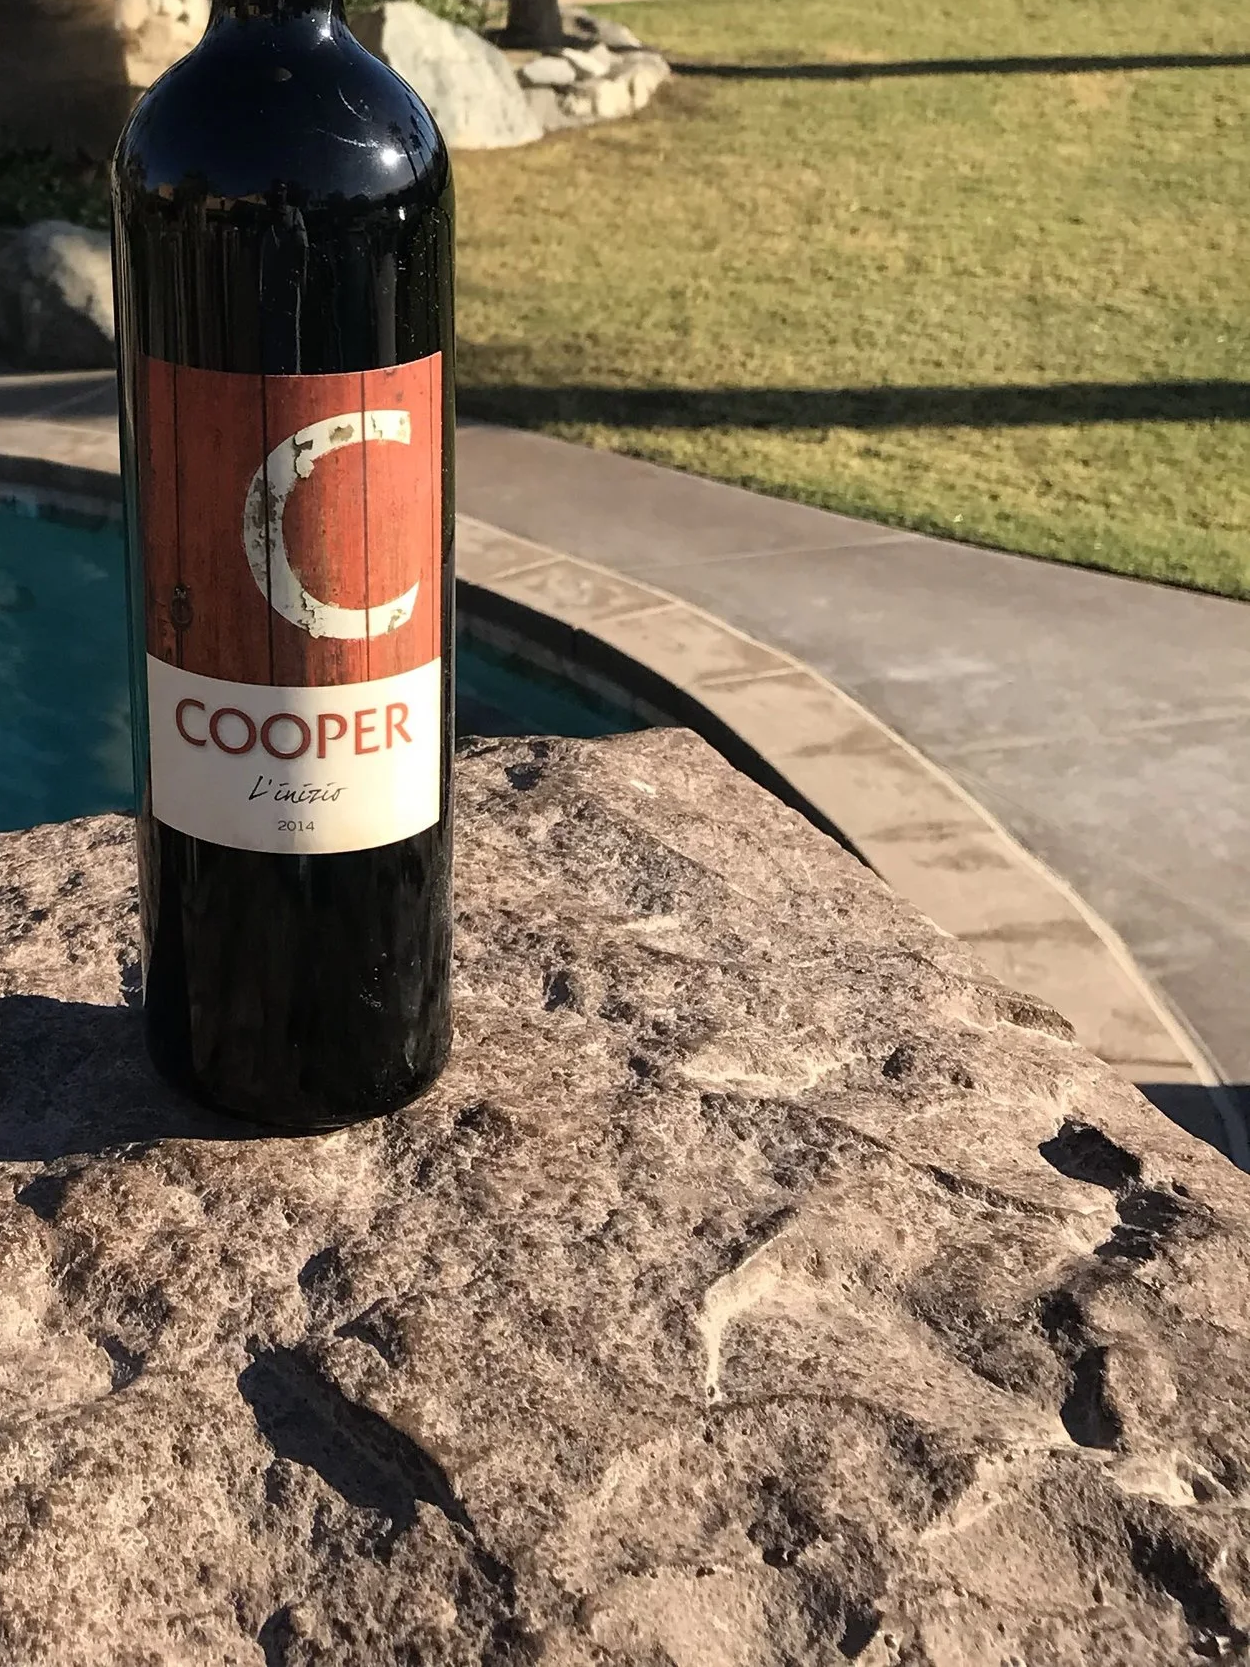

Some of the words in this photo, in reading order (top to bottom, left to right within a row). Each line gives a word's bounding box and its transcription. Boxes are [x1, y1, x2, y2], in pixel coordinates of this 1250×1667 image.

[175, 698, 412, 759] COOPER
[248, 775, 348, 804] L'inizio
[277, 820, 316, 832] 2014
